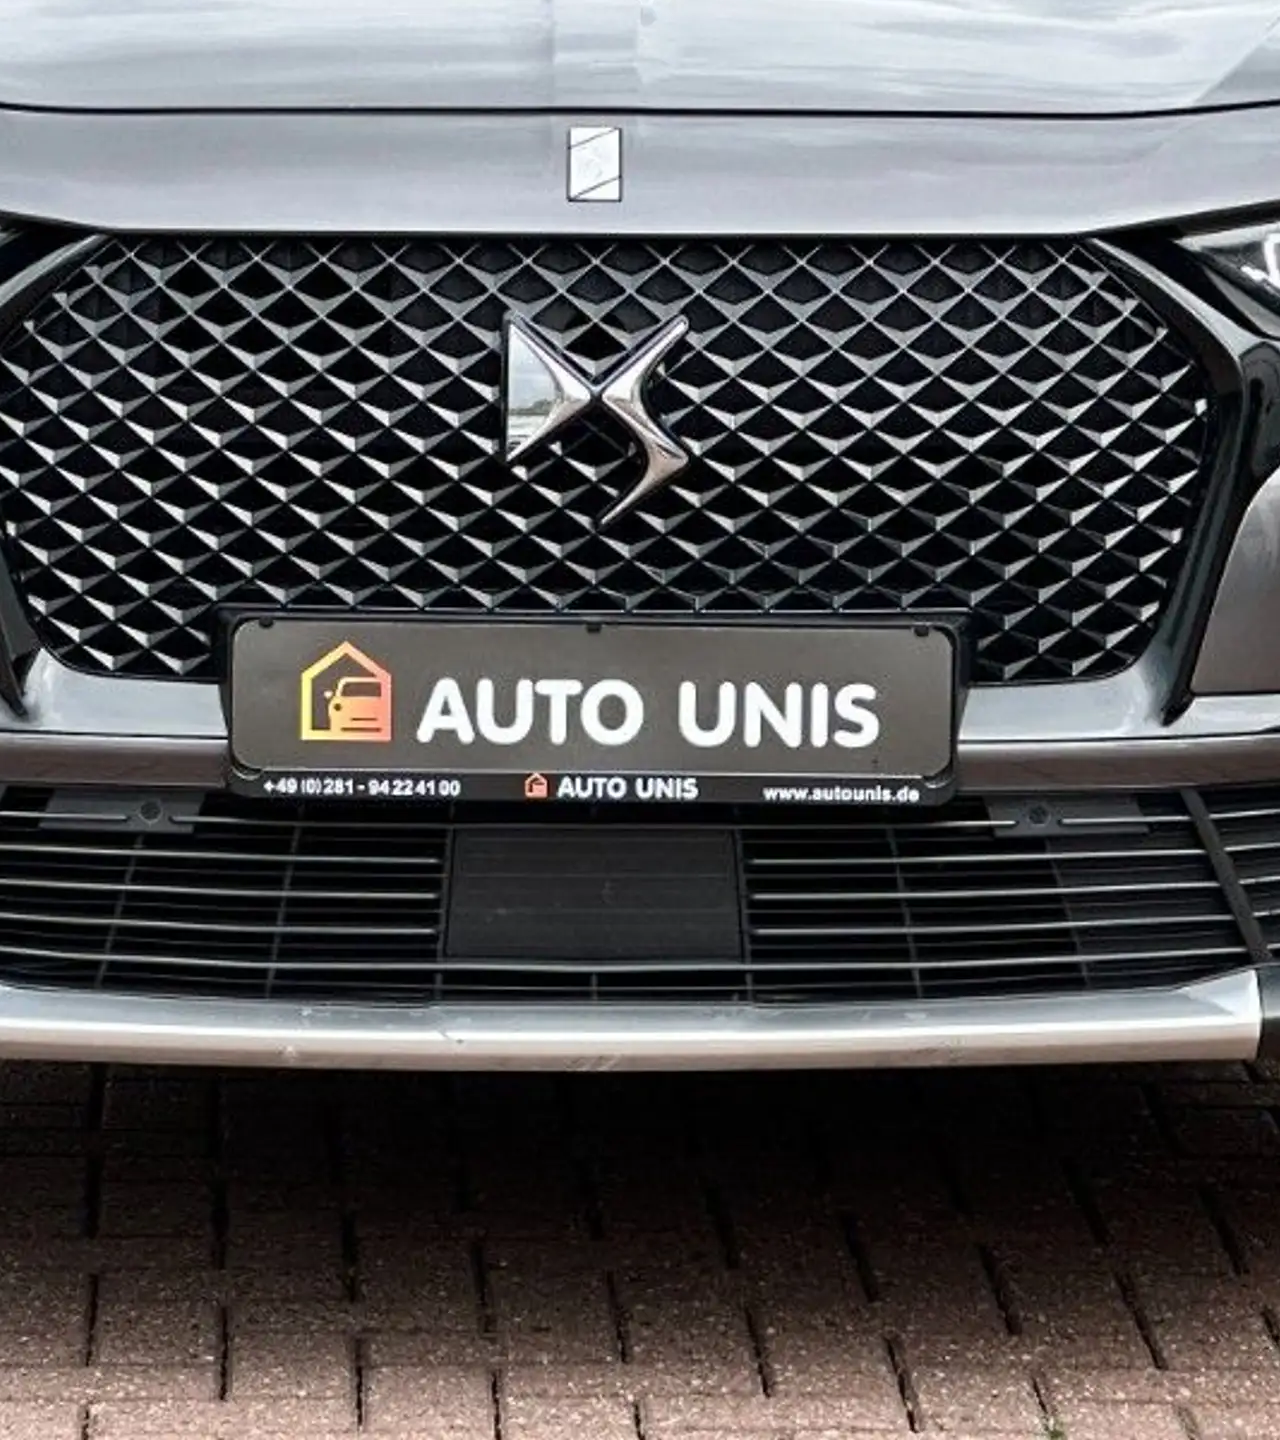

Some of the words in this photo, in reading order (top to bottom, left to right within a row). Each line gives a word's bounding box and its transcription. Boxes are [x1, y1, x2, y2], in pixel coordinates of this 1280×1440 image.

[416, 676, 644, 746] AUTO
[678, 680, 880, 749] UNIS
[263, 777, 298, 795] +49
[556, 776, 628, 800] AUTO
[634, 777, 699, 801] UNIS
[762, 784, 920, 804] www.autounis.de
